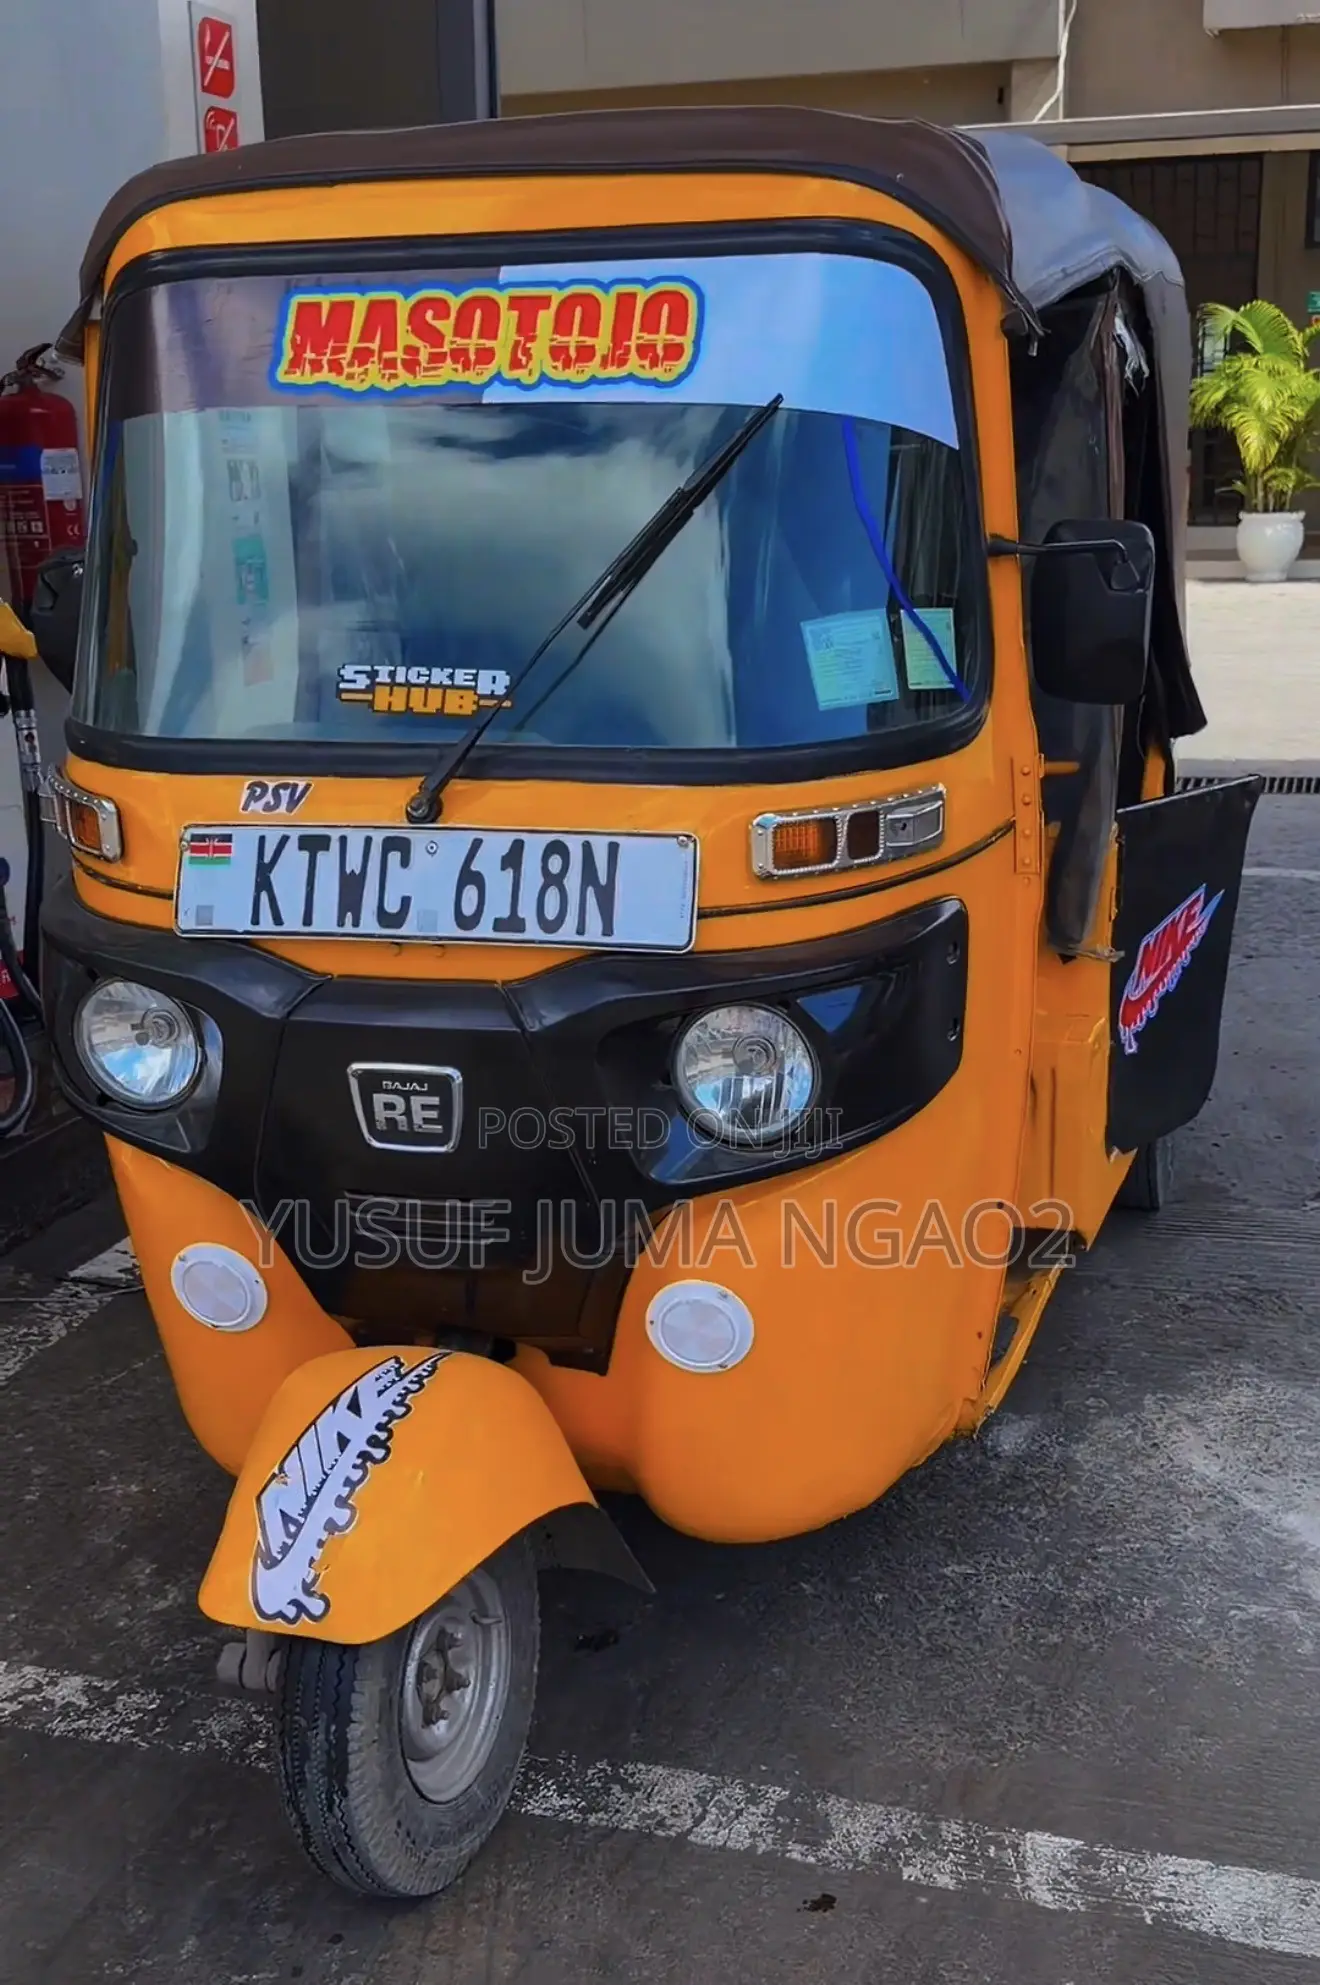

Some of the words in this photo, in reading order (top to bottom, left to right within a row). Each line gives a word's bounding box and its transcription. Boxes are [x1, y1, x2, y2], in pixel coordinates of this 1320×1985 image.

[284, 291, 692, 382] MASOTOJO
[339, 664, 510, 696] STICKER
[373, 685, 479, 716] HUB
[242, 782, 312, 814] PSV
[250, 834, 412, 930] KTWC
[453, 837, 620, 937] 618N
[382, 1080, 428, 1091] BAJAJ
[373, 1093, 443, 1133] RE
